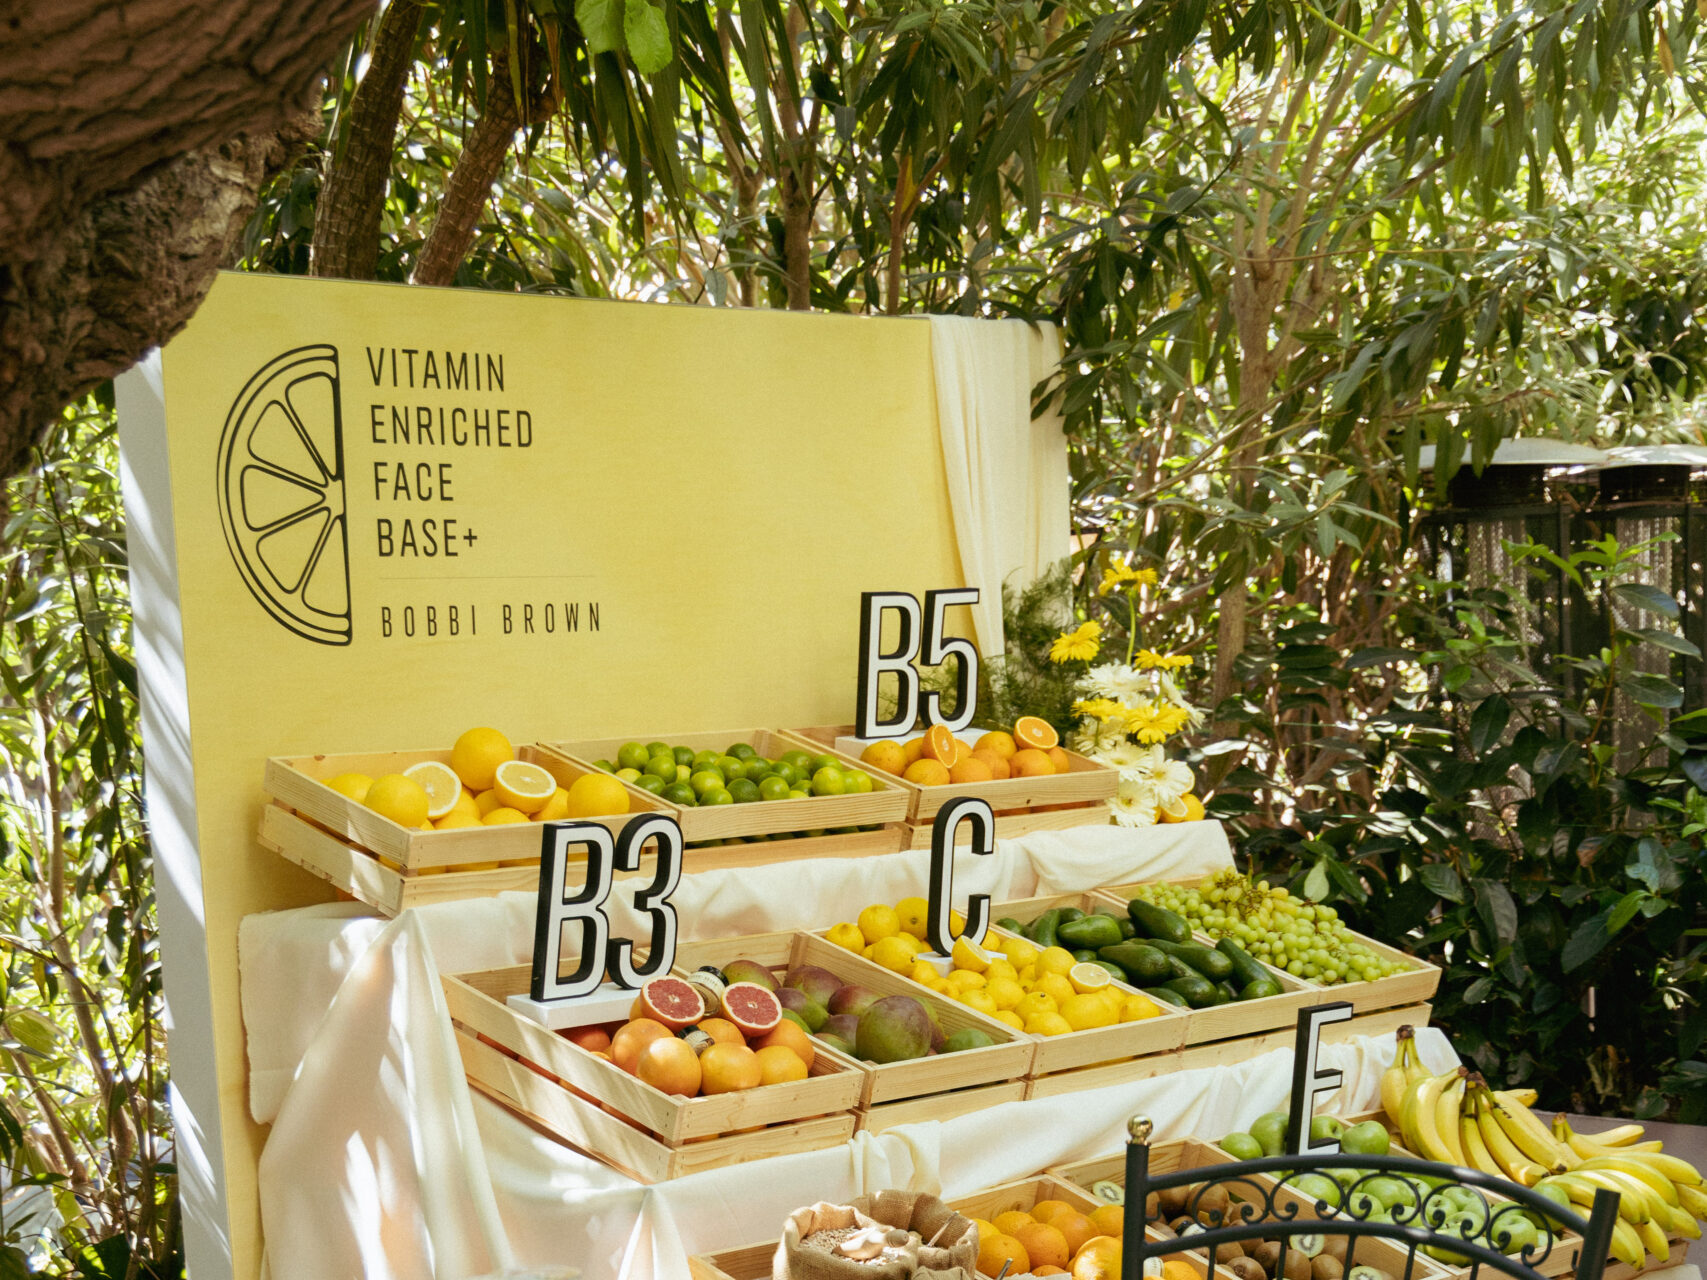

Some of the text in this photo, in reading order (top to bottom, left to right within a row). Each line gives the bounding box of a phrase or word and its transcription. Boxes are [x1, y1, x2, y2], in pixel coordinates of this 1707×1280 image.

[366, 346, 505, 392] VITAMIN
[370, 404, 533, 448] ENRICHED
[374, 461, 454, 501] FACE
[377, 518, 478, 557] BASE+
[381, 602, 601, 638] BOBBI BROWN
[856, 587, 980, 739] B5
[926, 796, 996, 958] C
[530, 813, 684, 1002] B3
[1286, 1001, 1354, 1155] E
